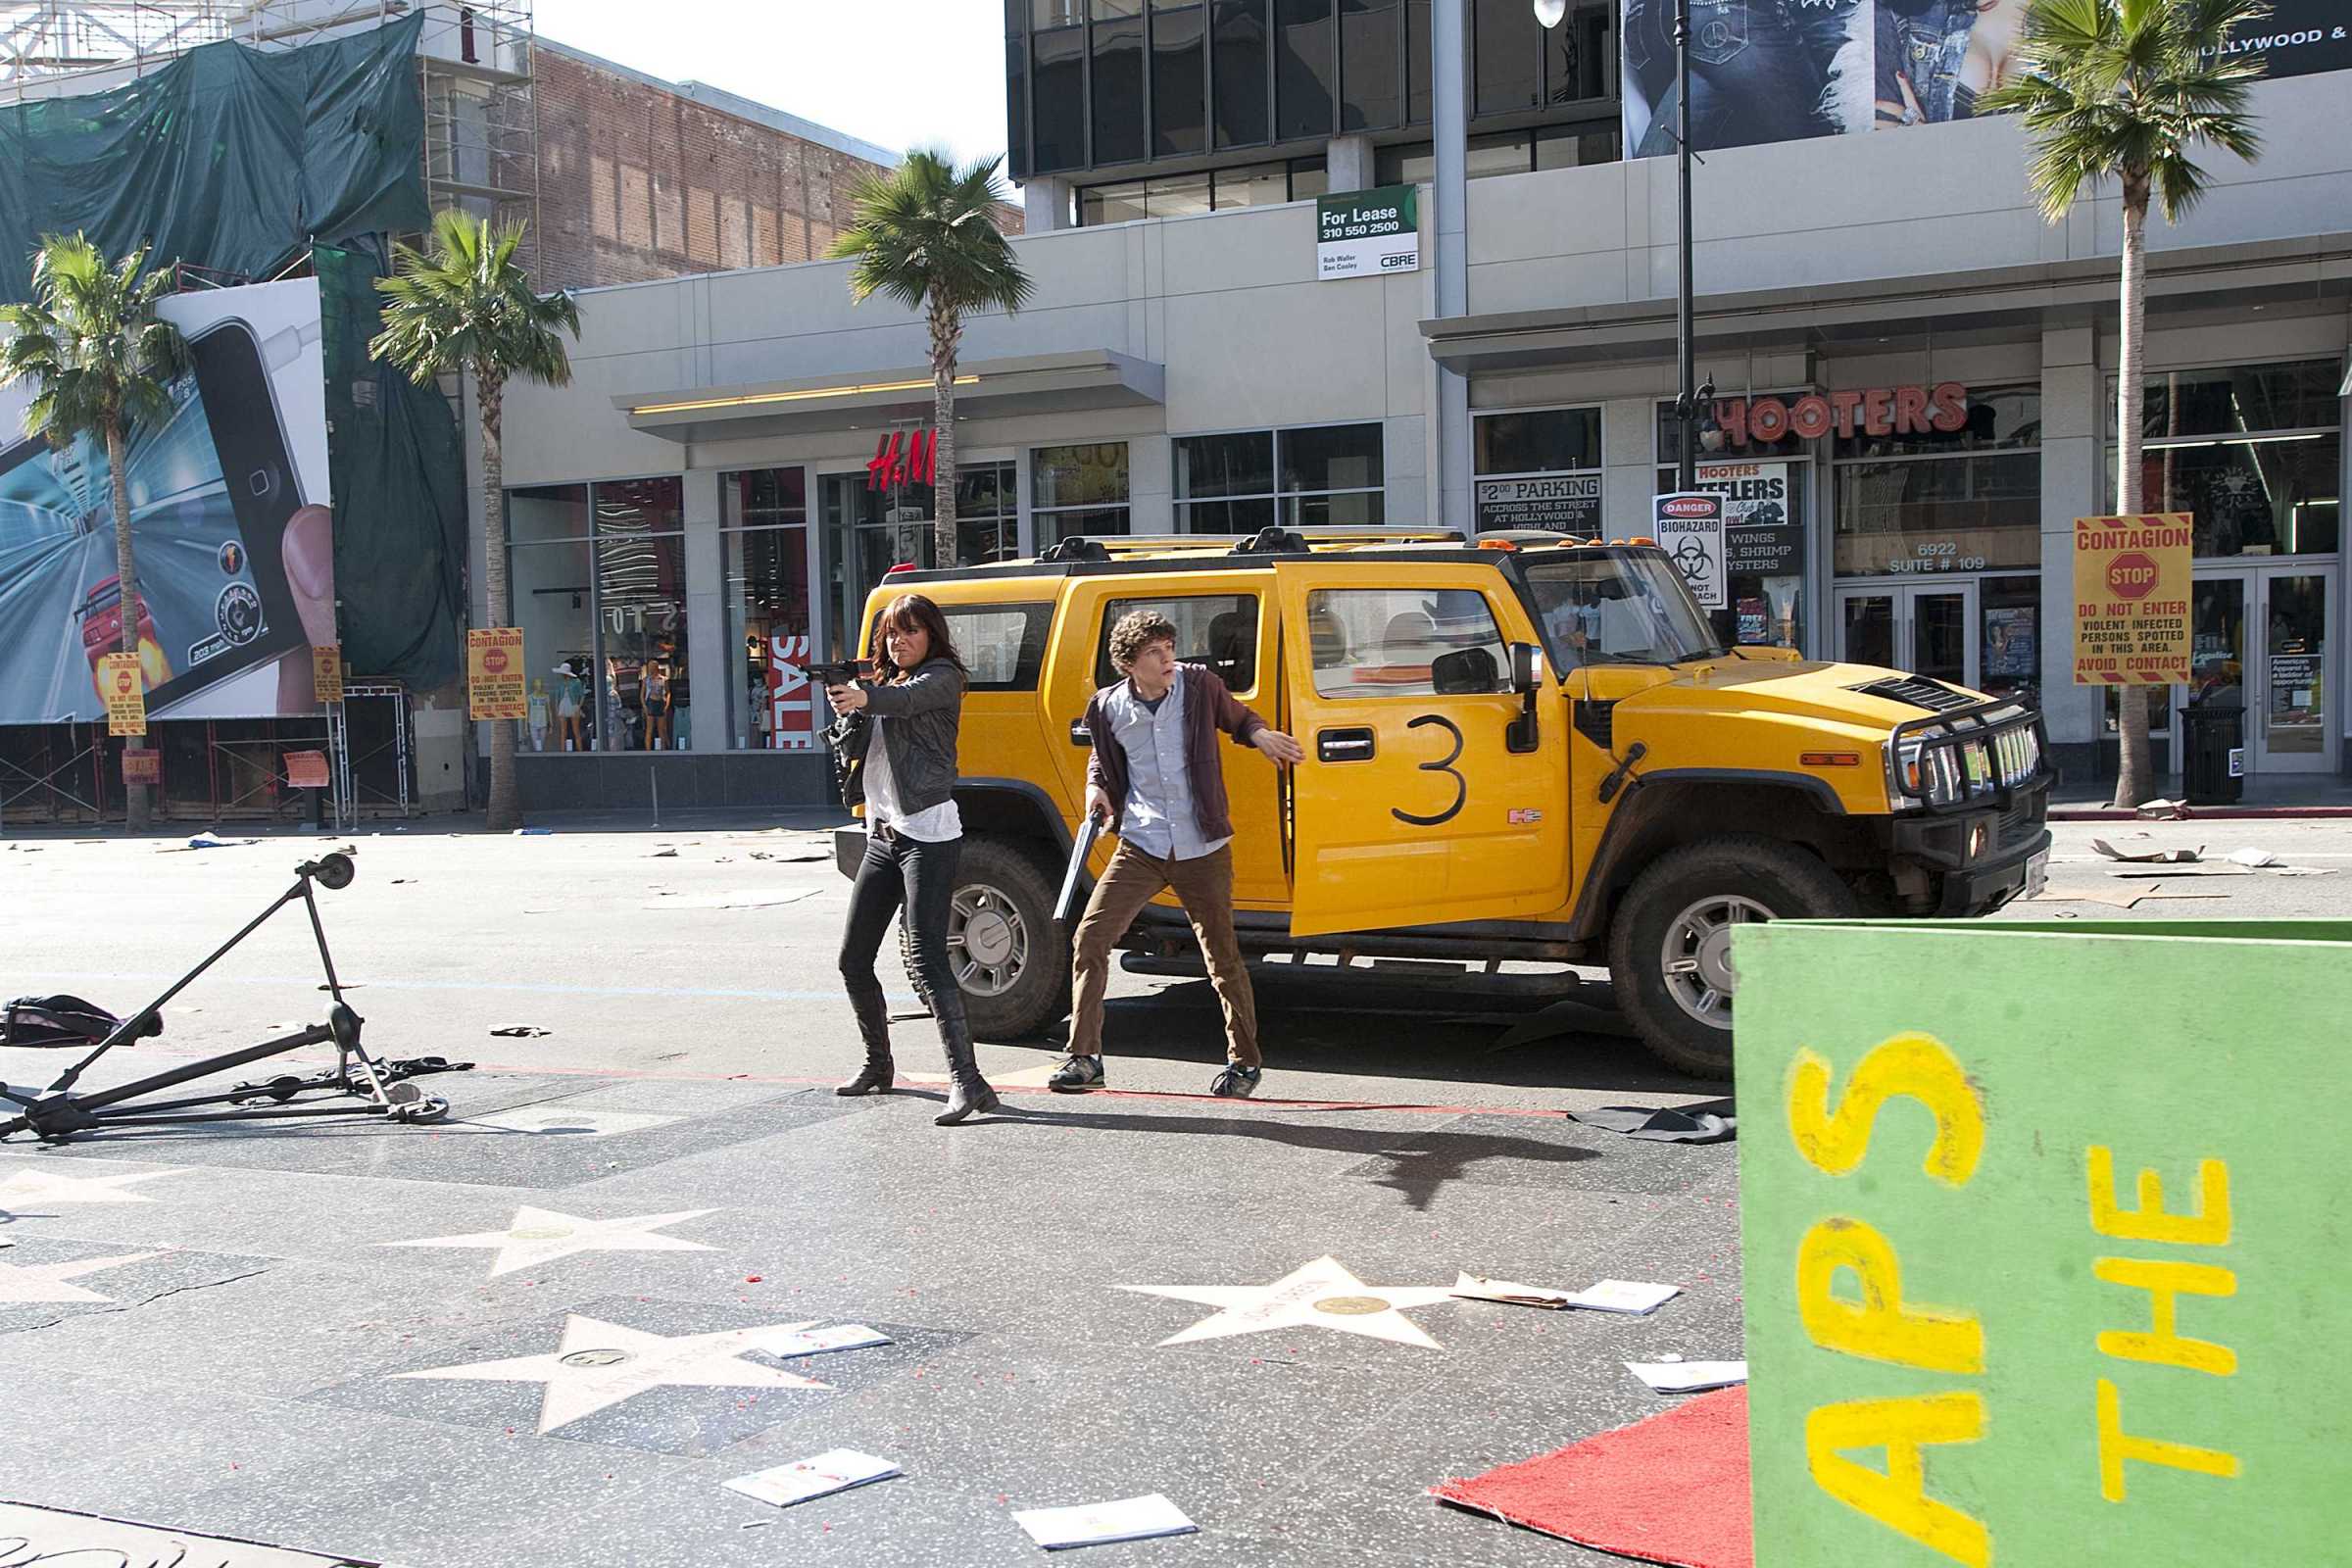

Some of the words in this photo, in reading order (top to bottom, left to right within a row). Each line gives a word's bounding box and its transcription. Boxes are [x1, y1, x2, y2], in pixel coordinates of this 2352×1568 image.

[2201, 29, 2322, 57] OLLYWOOD
[2331, 25, 2347, 39] &
[1322, 212, 1347, 225] For
[1352, 208, 1397, 222] Lease
[1323, 227, 1342, 239] 310
[1345, 225, 1366, 235] 550
[1370, 221, 1399, 233] 2500
[1380, 255, 1415, 268] CBRE
[1714, 382, 1968, 447] HOOTERS
[1699, 465, 1760, 479] HOOTERS
[1515, 479, 1597, 498] PARKING
[1483, 504, 1528, 514] ACCROSS
[1531, 502, 1552, 512] THE
[1554, 500, 1597, 510] STREET
[1667, 504, 1712, 513] DANGER
[1494, 514, 1509, 523] AT
[1511, 512, 1574, 522] HOLLYWOOD
[1661, 521, 1719, 533] BIOHAZARD
[1731, 533, 1776, 543] WINGS
[2077, 528, 2189, 551] CONTAGION
[1740, 546, 1791, 557] SHRIMP
[1918, 542, 1957, 557] 6922
[1727, 559, 1780, 570] YSTERS
[1889, 559, 1933, 572] SUITE
[1941, 558, 1951, 570] #
[1958, 557, 1985, 569] 109
[2111, 566, 2154, 584] STOP
[2079, 604, 2096, 617] DO
[2107, 603, 2132, 615] NOT
[2142, 601, 2187, 615] ENTER
[2082, 620, 2125, 631] VIOLENT
[2132, 619, 2182, 629] INFECTED
[470, 635, 521, 647] CONTAGION
[2082, 632, 2131, 643] PERSONS
[2137, 631, 2184, 641] SPOTTED
[194, 646, 210, 661] 203
[2092, 645, 2103, 654] IN
[2111, 643, 2133, 653] THIS
[2141, 643, 2172, 653] AREA.
[485, 657, 506, 666] STOP
[2078, 659, 2117, 670] AVOID
[2127, 657, 2187, 670] CONTACT
[771, 635, 812, 749] SALE
[1391, 713, 1466, 825] 3
[1785, 1029, 1992, 1568] APS
[2084, 1144, 2243, 1503] THE
